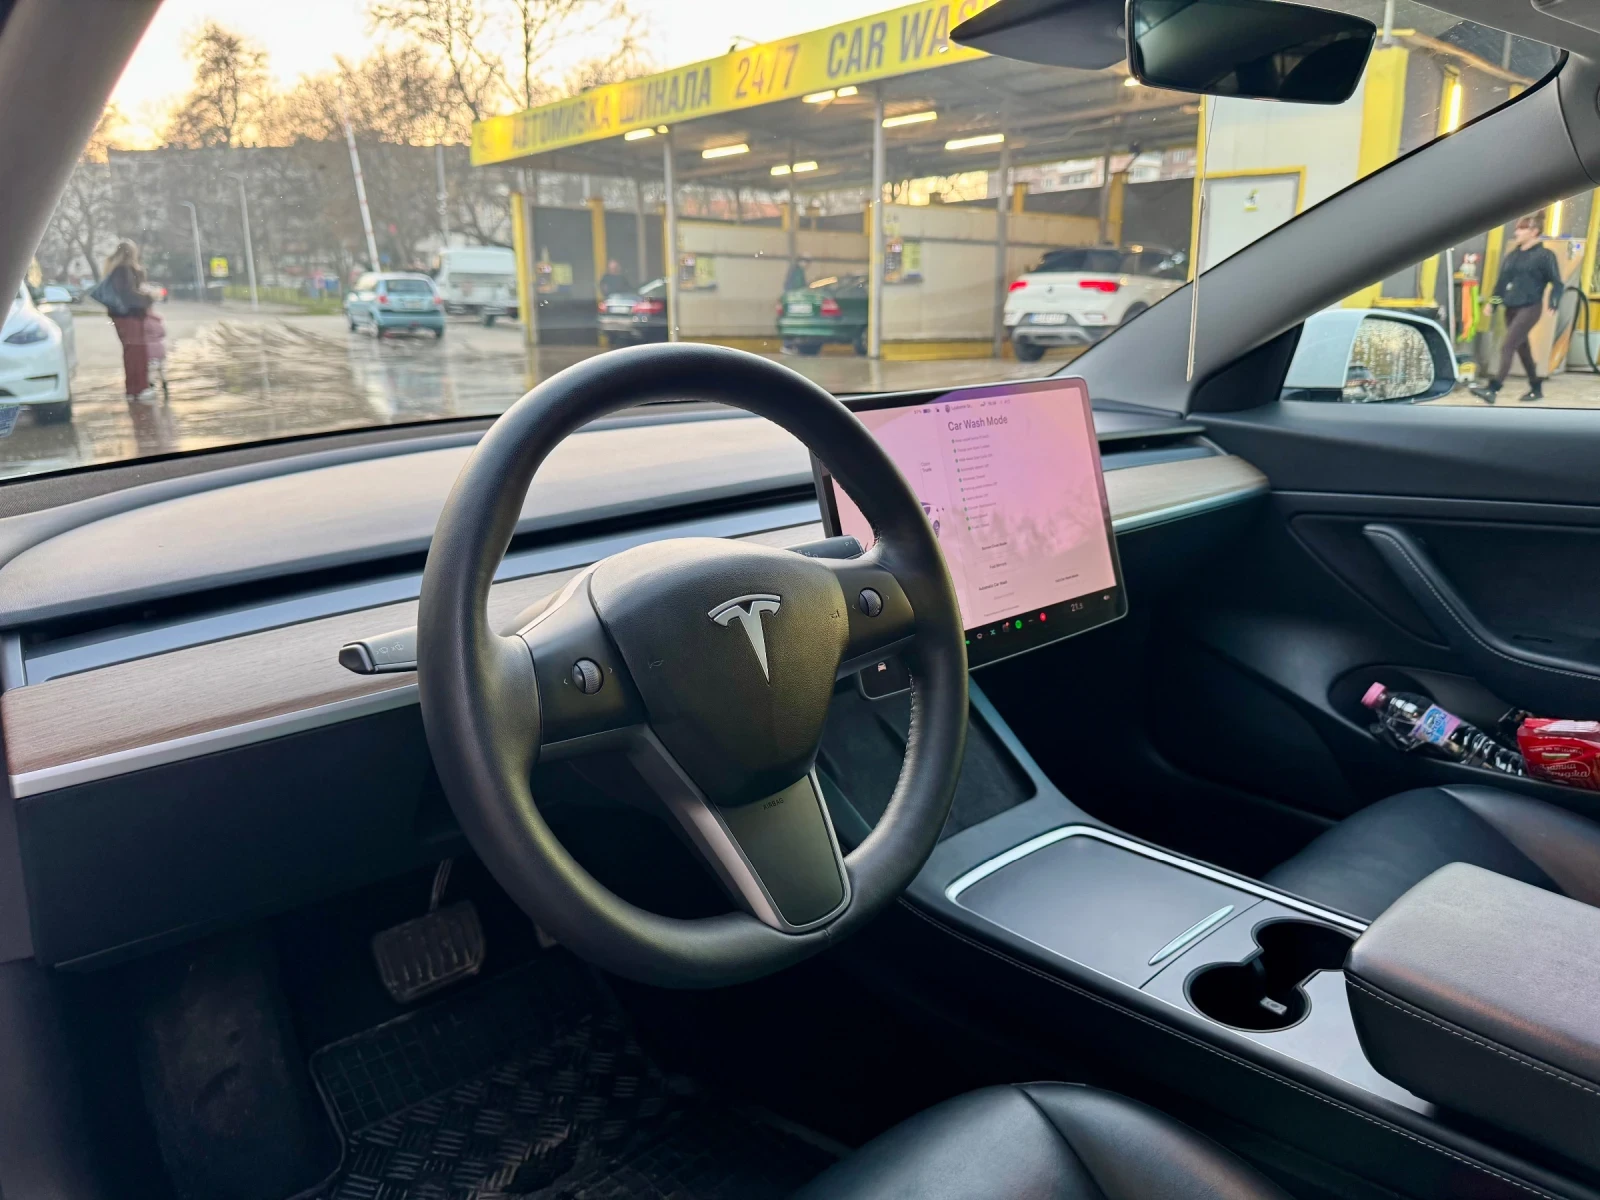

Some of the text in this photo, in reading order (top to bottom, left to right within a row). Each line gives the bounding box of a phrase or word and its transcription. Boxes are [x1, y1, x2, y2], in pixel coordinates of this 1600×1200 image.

[734, 43, 799, 100] 24/7
[826, 21, 888, 80] CAR
[947, 415, 1008, 431] Car Wash Mode
[762, 797, 785, 811] AIRBAG
